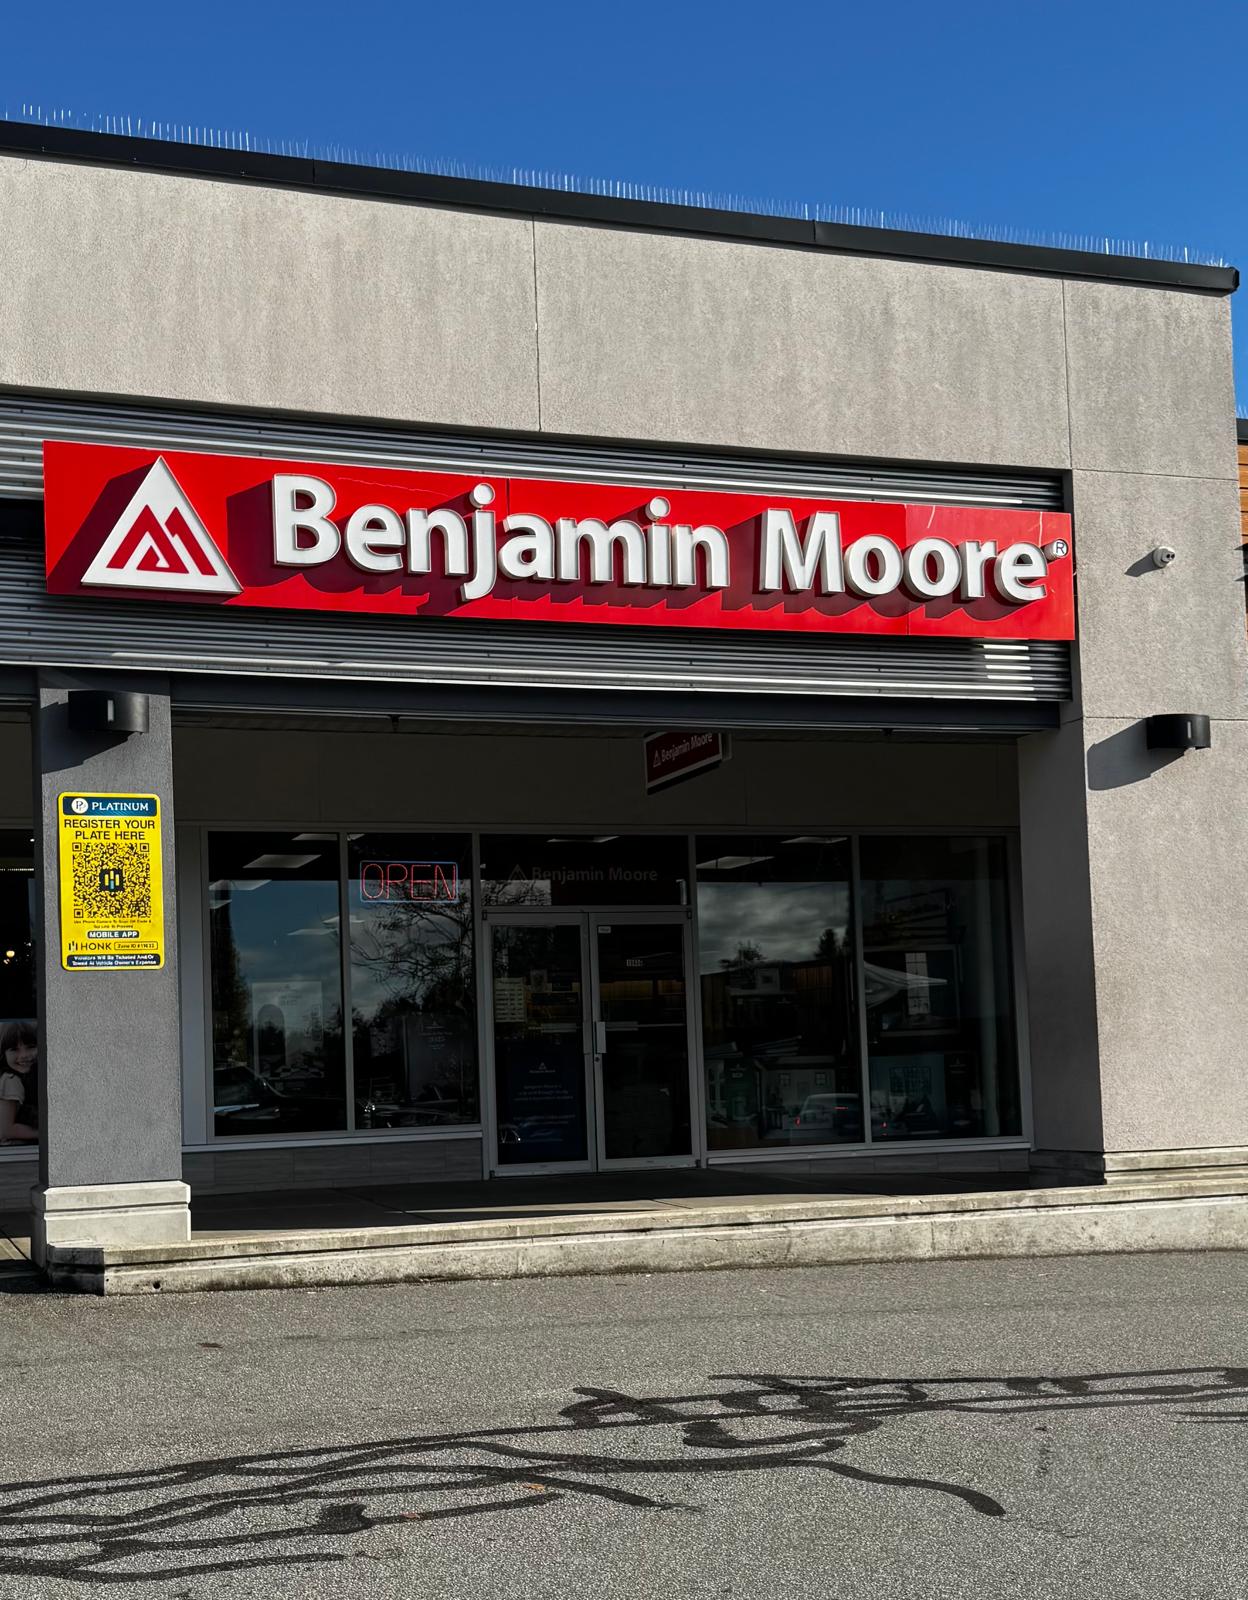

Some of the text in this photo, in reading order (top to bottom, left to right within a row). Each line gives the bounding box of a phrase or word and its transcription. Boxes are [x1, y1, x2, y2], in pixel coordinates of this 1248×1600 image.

[271, 473, 730, 602] Benjamin
[661, 739, 691, 763] Benjamin
[91, 801, 149, 812] PLATINUM
[64, 818, 156, 830] REGISTER YOUR
[75, 830, 146, 841] PLATE HERE
[361, 863, 457, 900] OPEN
[532, 866, 658, 886] Benjamin Moore
[80, 942, 112, 951] HONK
